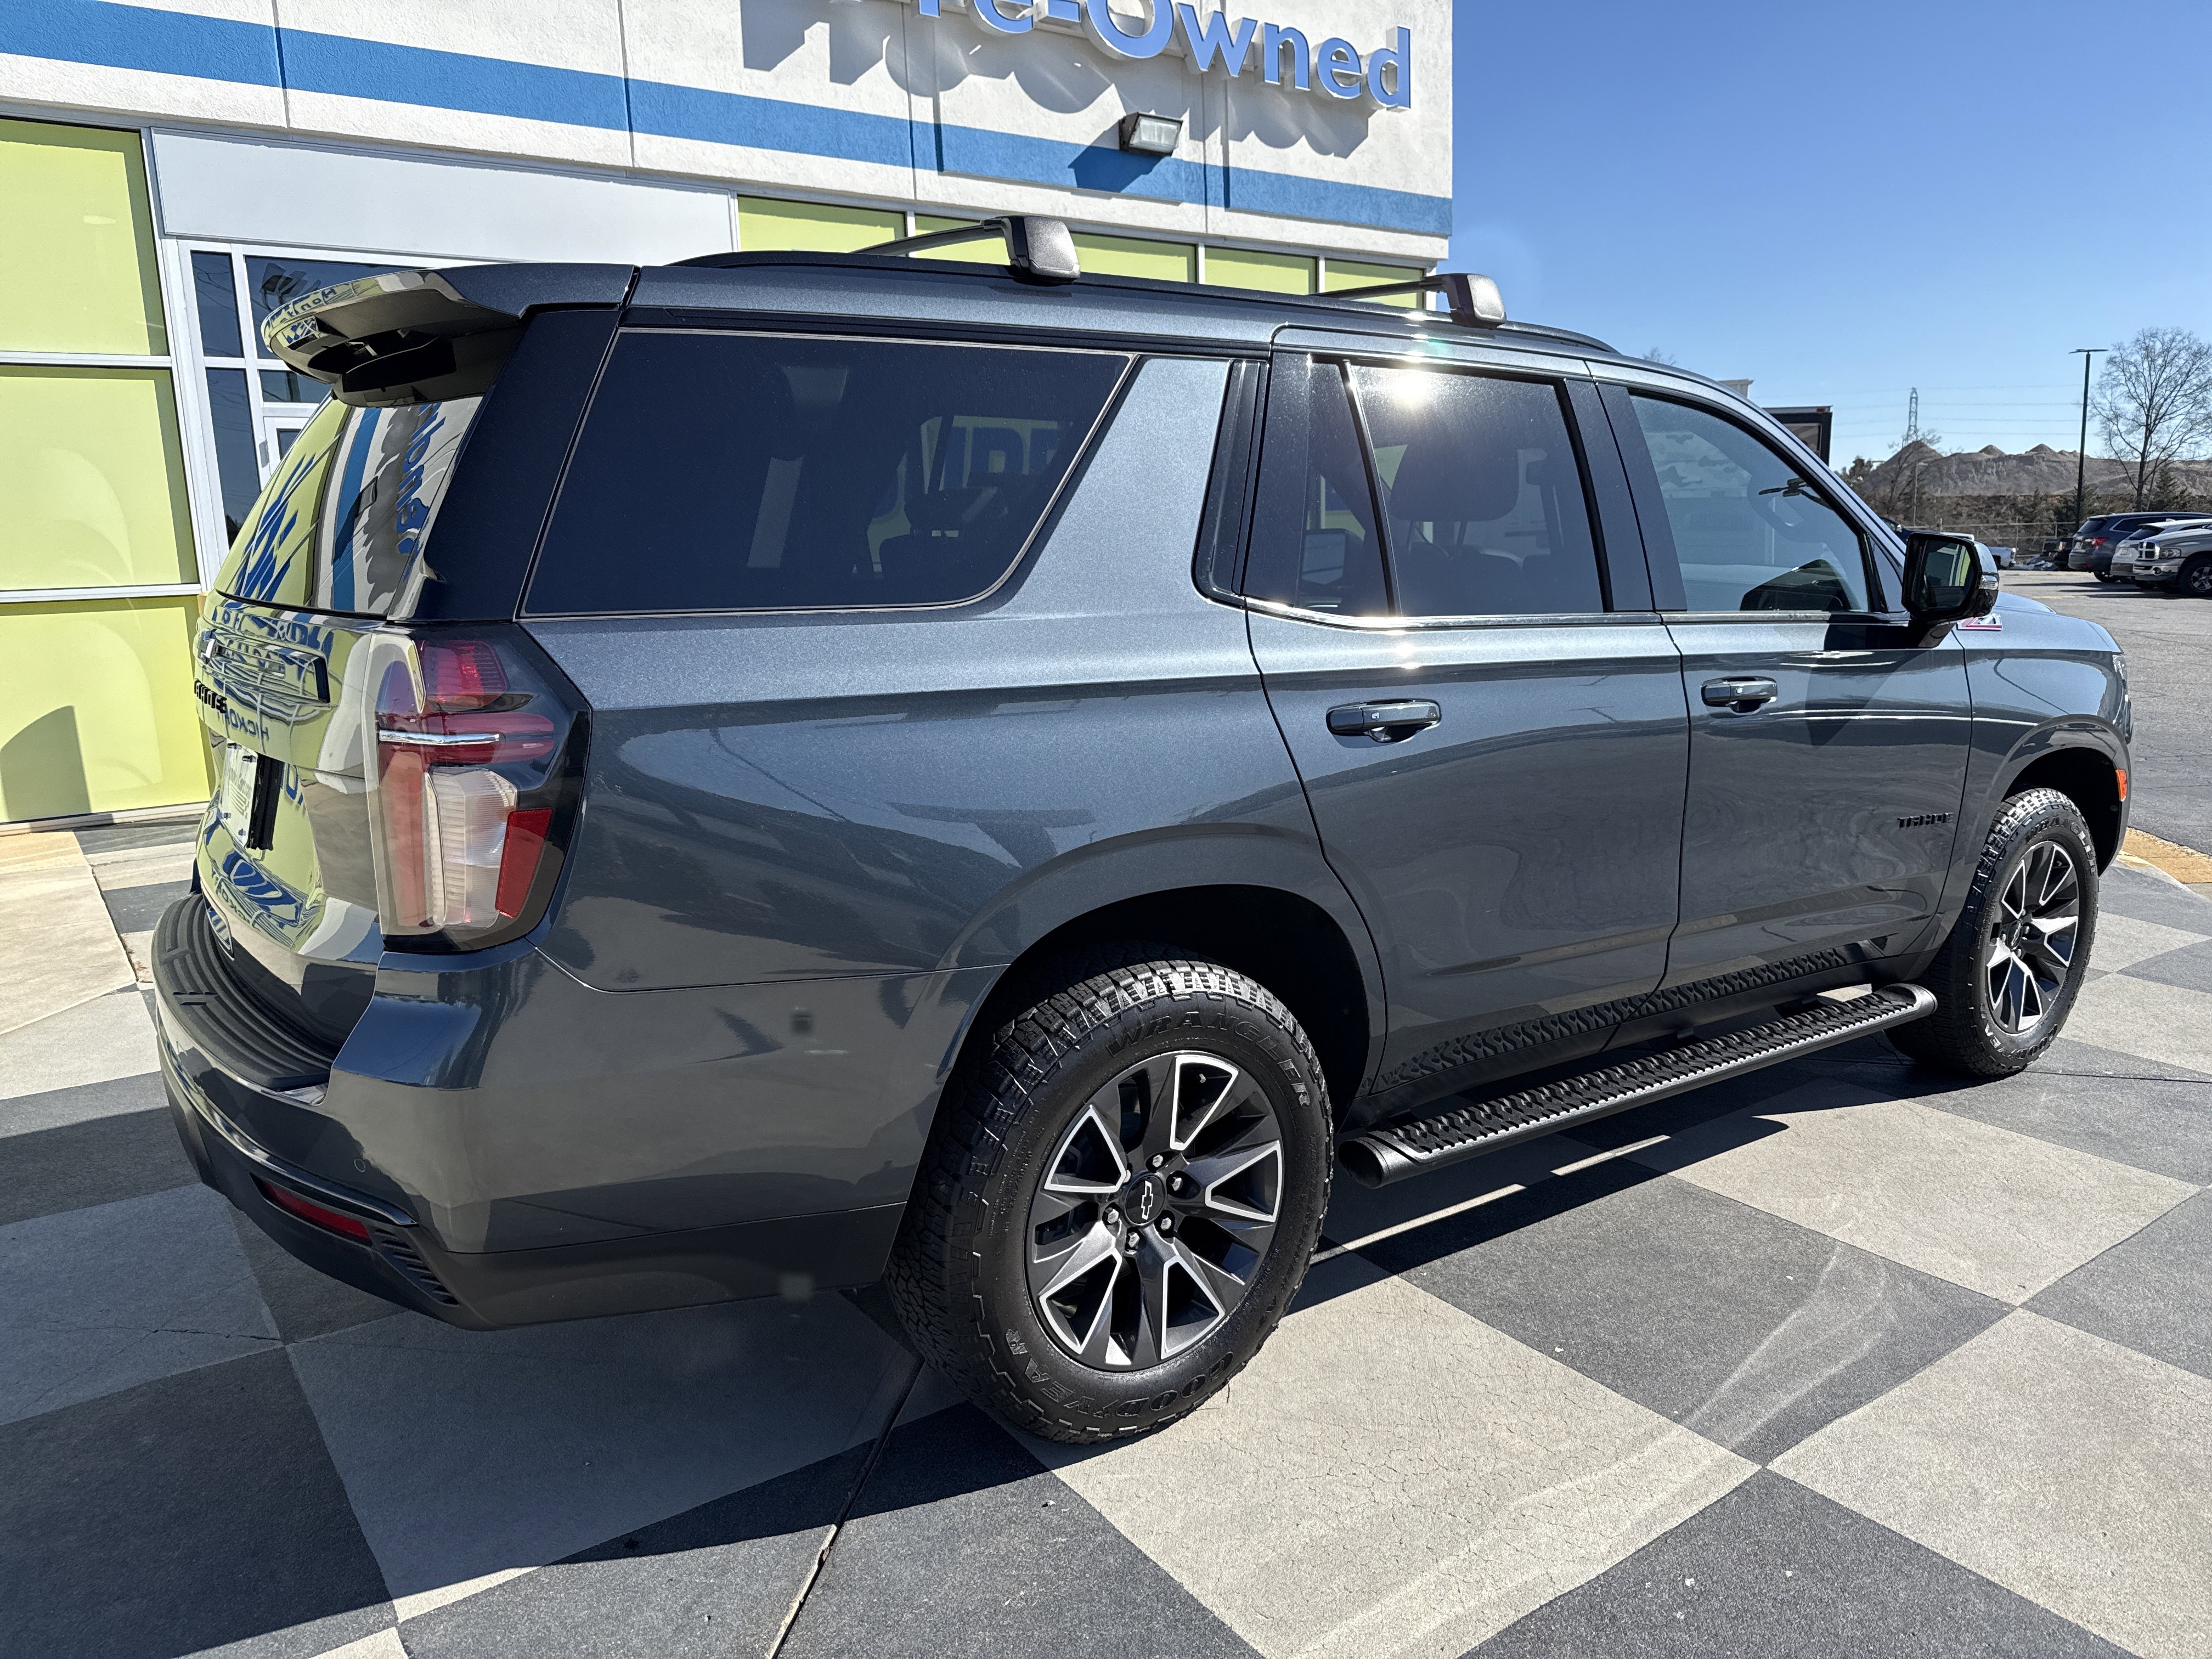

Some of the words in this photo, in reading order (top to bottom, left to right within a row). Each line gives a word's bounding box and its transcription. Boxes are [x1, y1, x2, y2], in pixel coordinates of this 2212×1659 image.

[919, 0, 1411, 109] e-Owned
[194, 678, 227, 714] AHOE
[1897, 812, 1955, 828] TAHOE
[1105, 1011, 1311, 1107] WRANGLER
[1005, 1327, 1234, 1419] GOODYEAR
